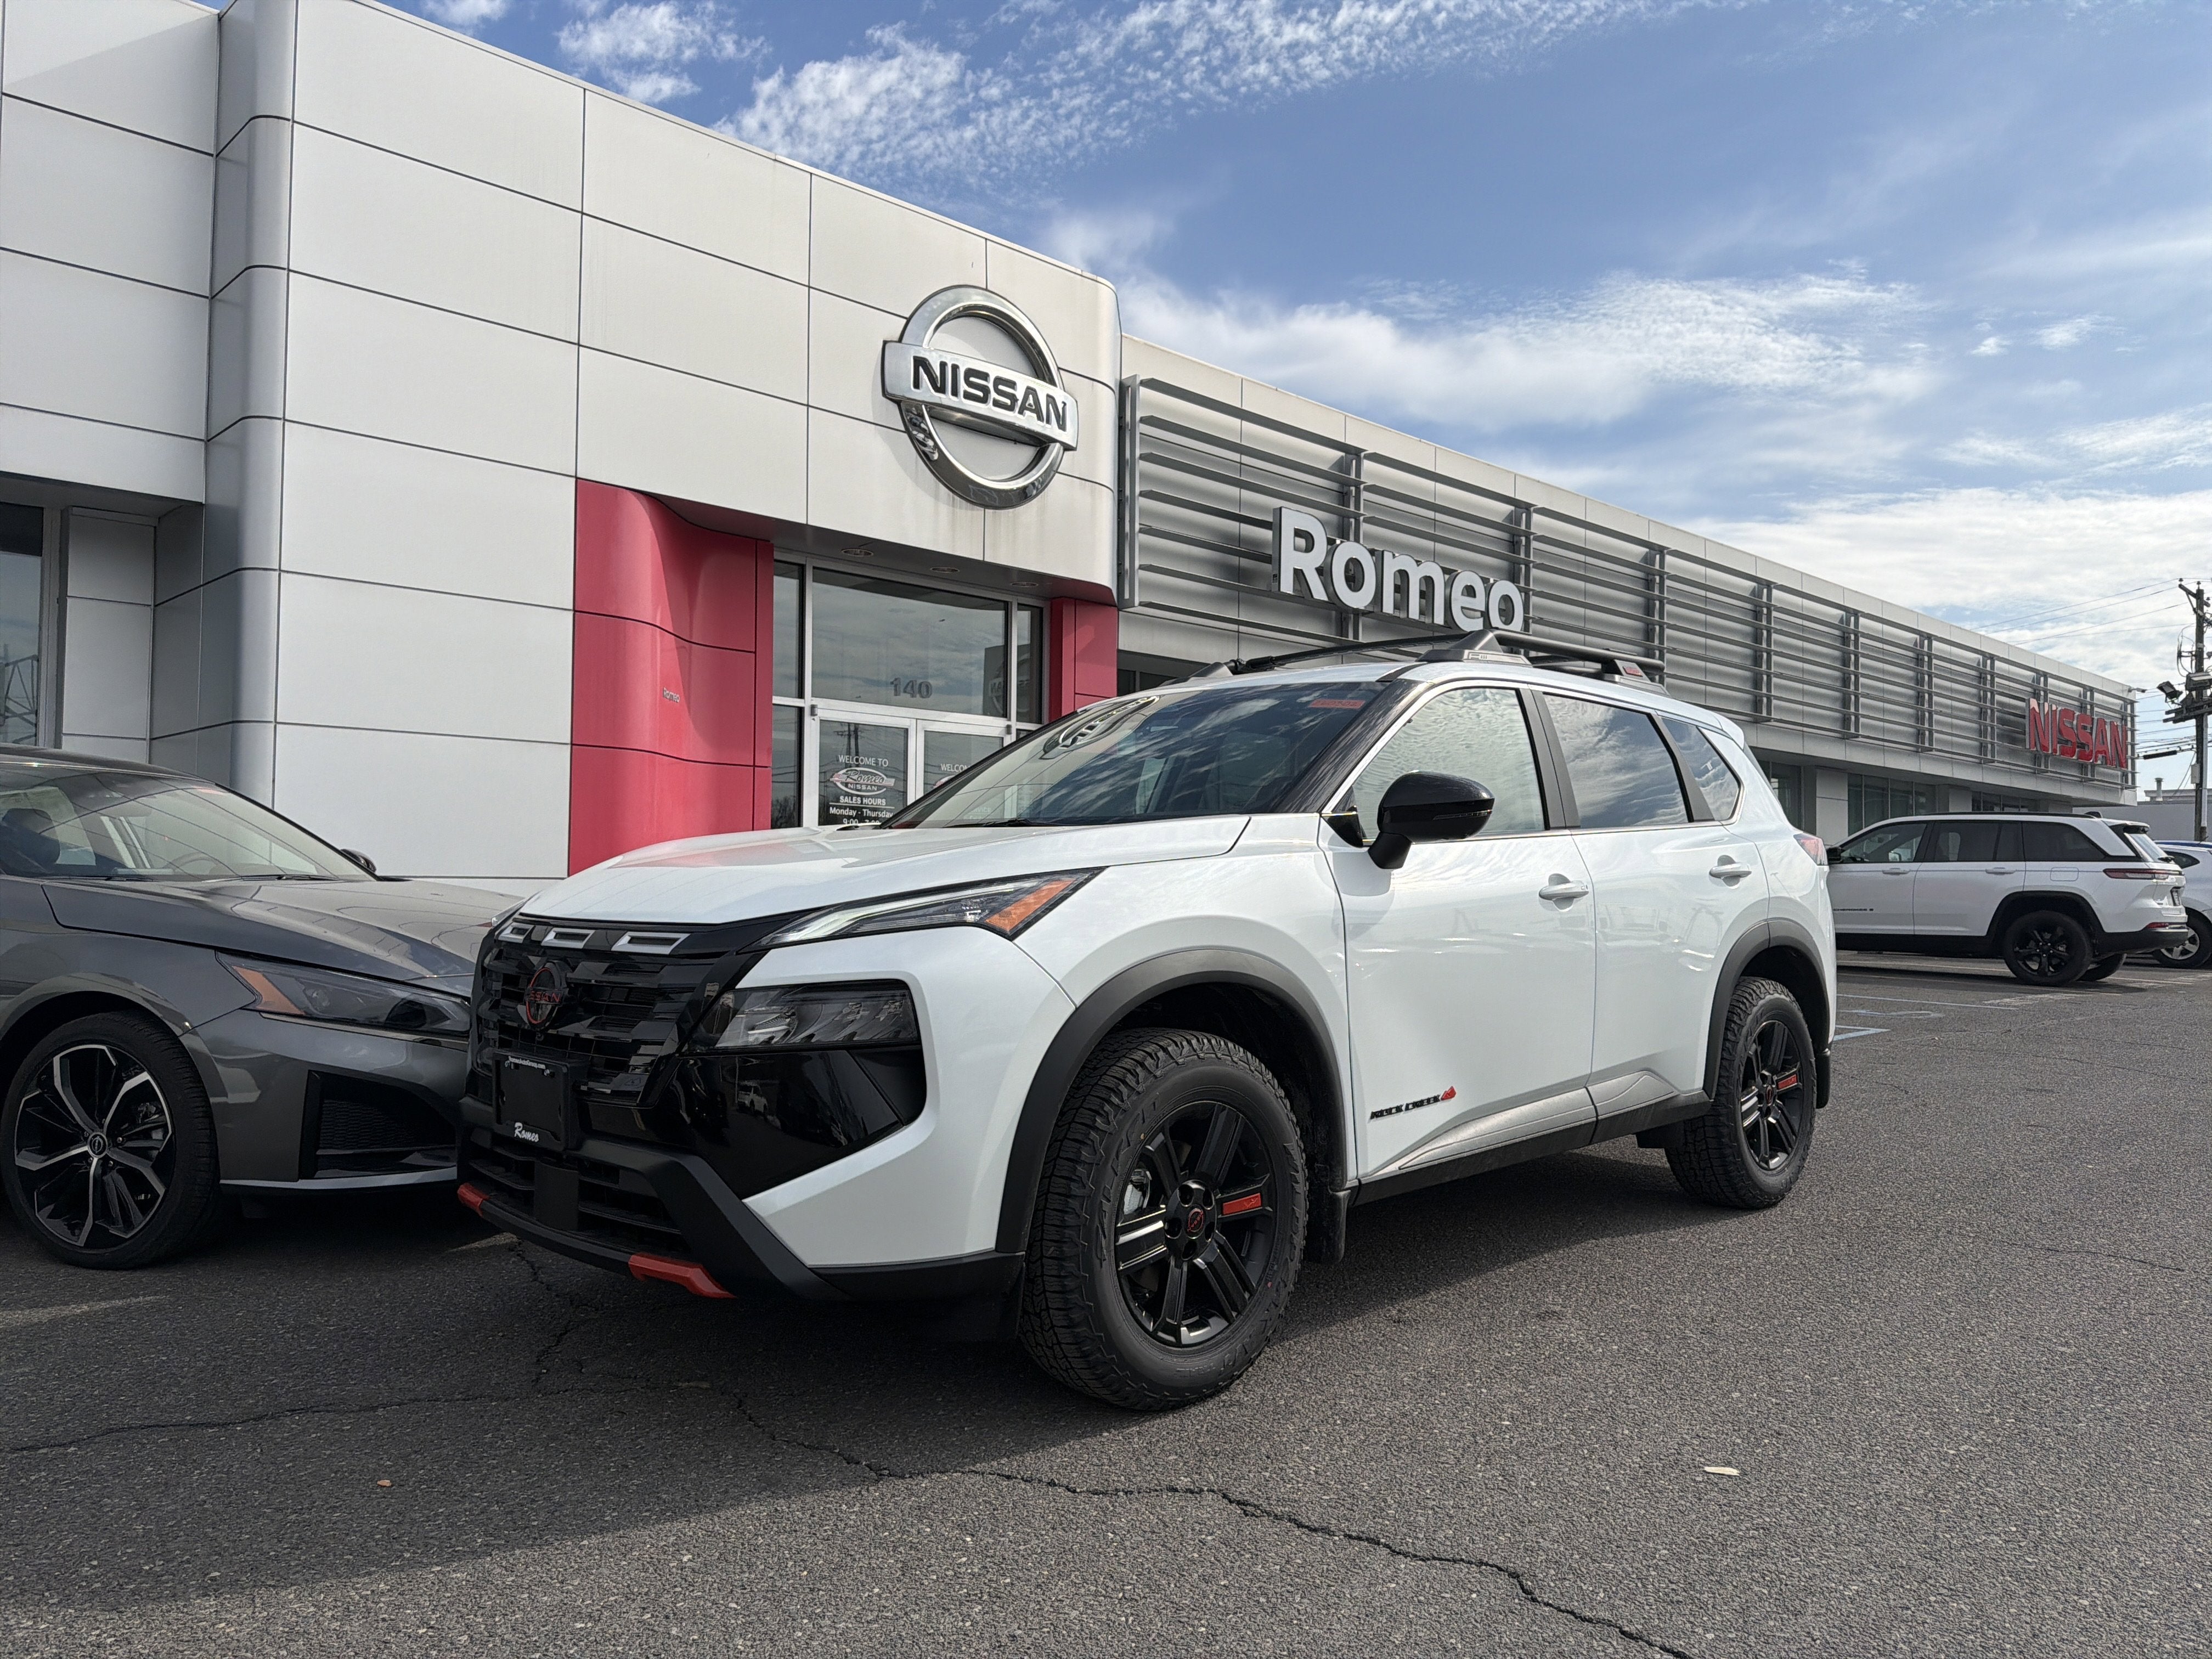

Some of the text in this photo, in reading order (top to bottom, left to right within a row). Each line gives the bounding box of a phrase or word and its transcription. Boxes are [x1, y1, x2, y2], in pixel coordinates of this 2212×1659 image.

[912, 354, 1068, 432] NISSAN
[1273, 506, 1524, 633] Romeo
[663, 687, 680, 703] Romeo
[890, 677, 933, 699] 140
[2029, 698, 2128, 770] NISSAN
[838, 755, 876, 766] WELCOME
[844, 769, 884, 784] Romeo
[840, 796, 886, 806] SALES HOURS
[830, 806, 857, 817] Monday
[863, 809, 894, 818] Thursday
[515, 1122, 539, 1143] Romeo
